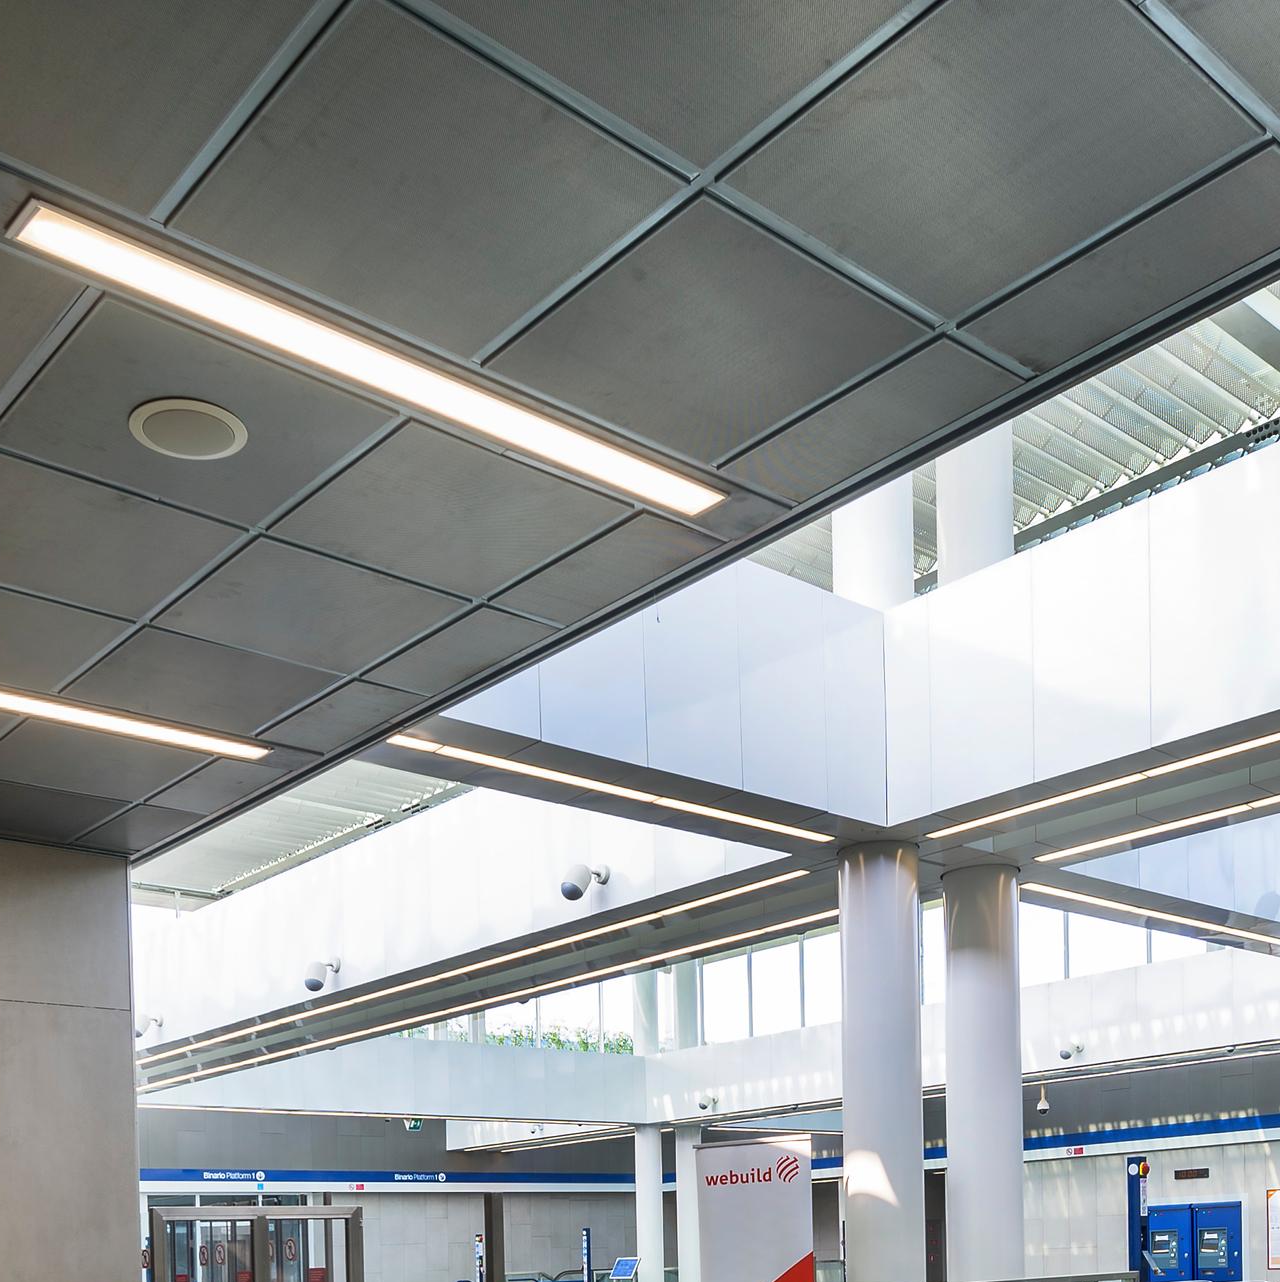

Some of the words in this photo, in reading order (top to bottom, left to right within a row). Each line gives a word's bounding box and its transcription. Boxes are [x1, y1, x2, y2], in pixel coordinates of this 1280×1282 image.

[203, 1172, 225, 1180] Binario
[226, 1172, 252, 1180] Platform
[705, 1167, 772, 1186] webuild
